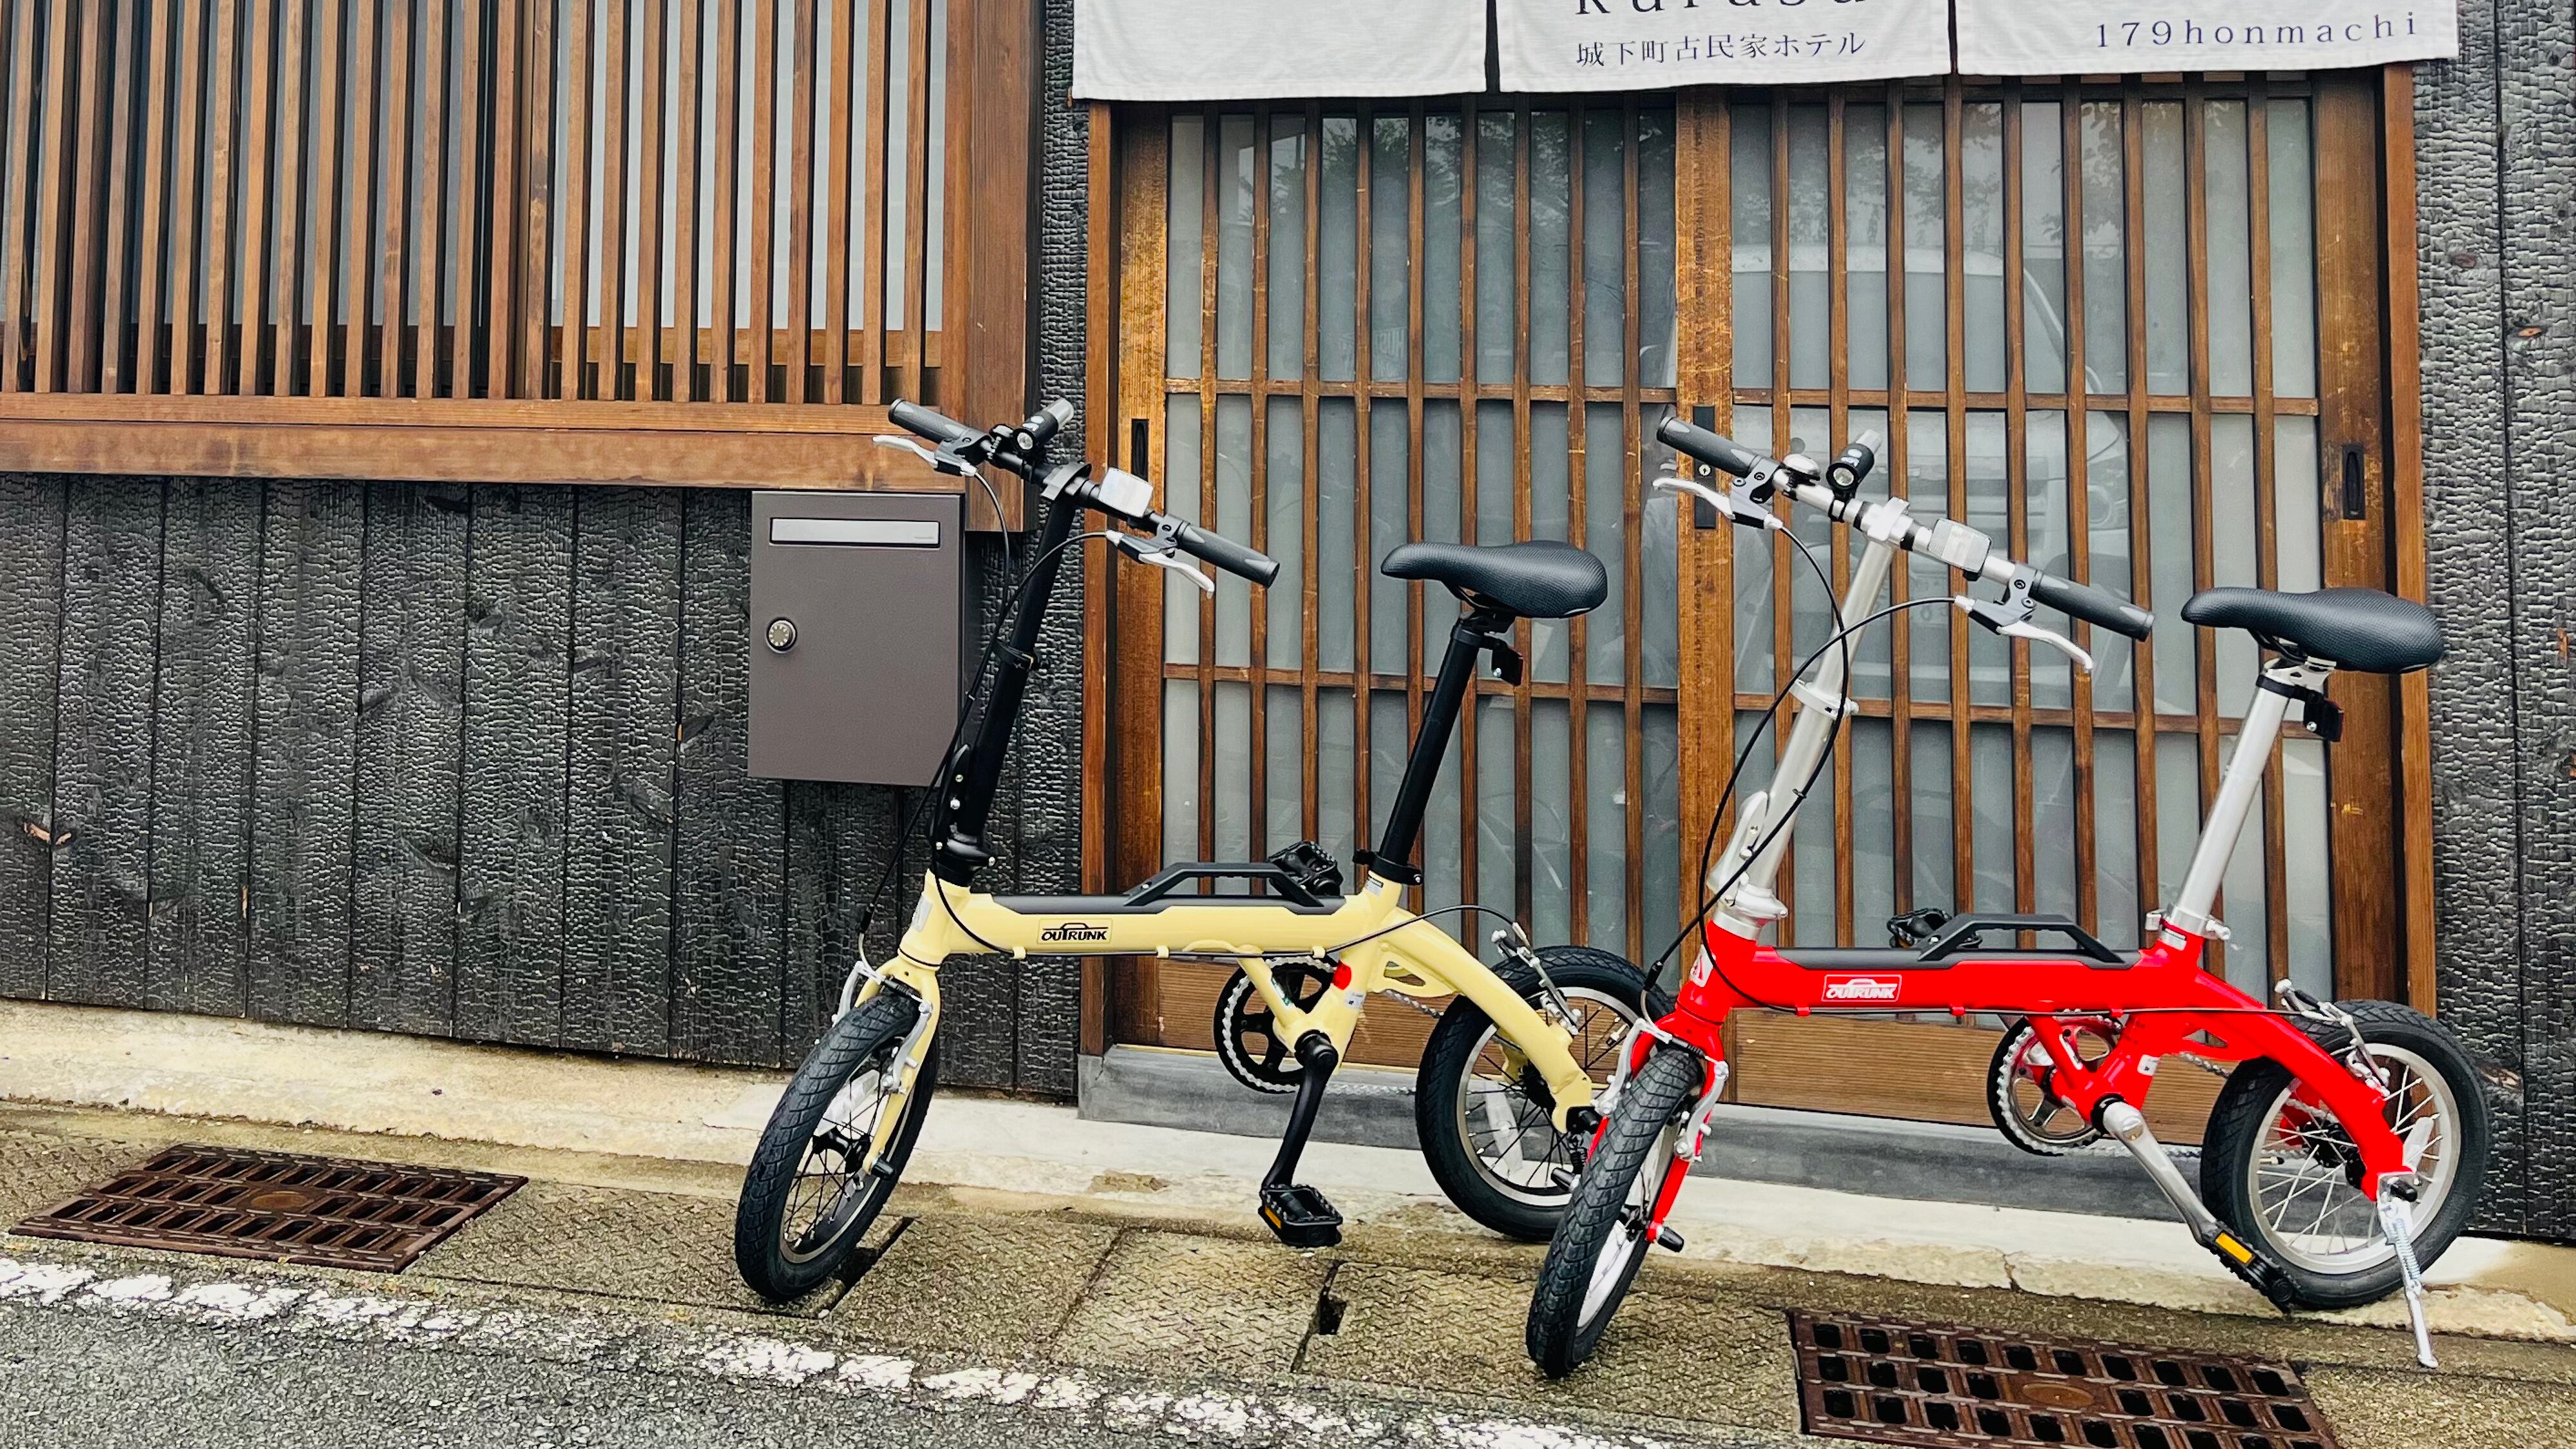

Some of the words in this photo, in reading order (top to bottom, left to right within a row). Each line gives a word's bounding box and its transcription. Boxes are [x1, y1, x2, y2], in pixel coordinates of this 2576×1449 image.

[2097, 12, 2416, 48] 179honmachi
[1575, 32, 1866, 68] 城下町古民家ホテル
[1041, 927, 1108, 941] OUTRUNK
[1826, 985, 1895, 999] OUTRUNK
